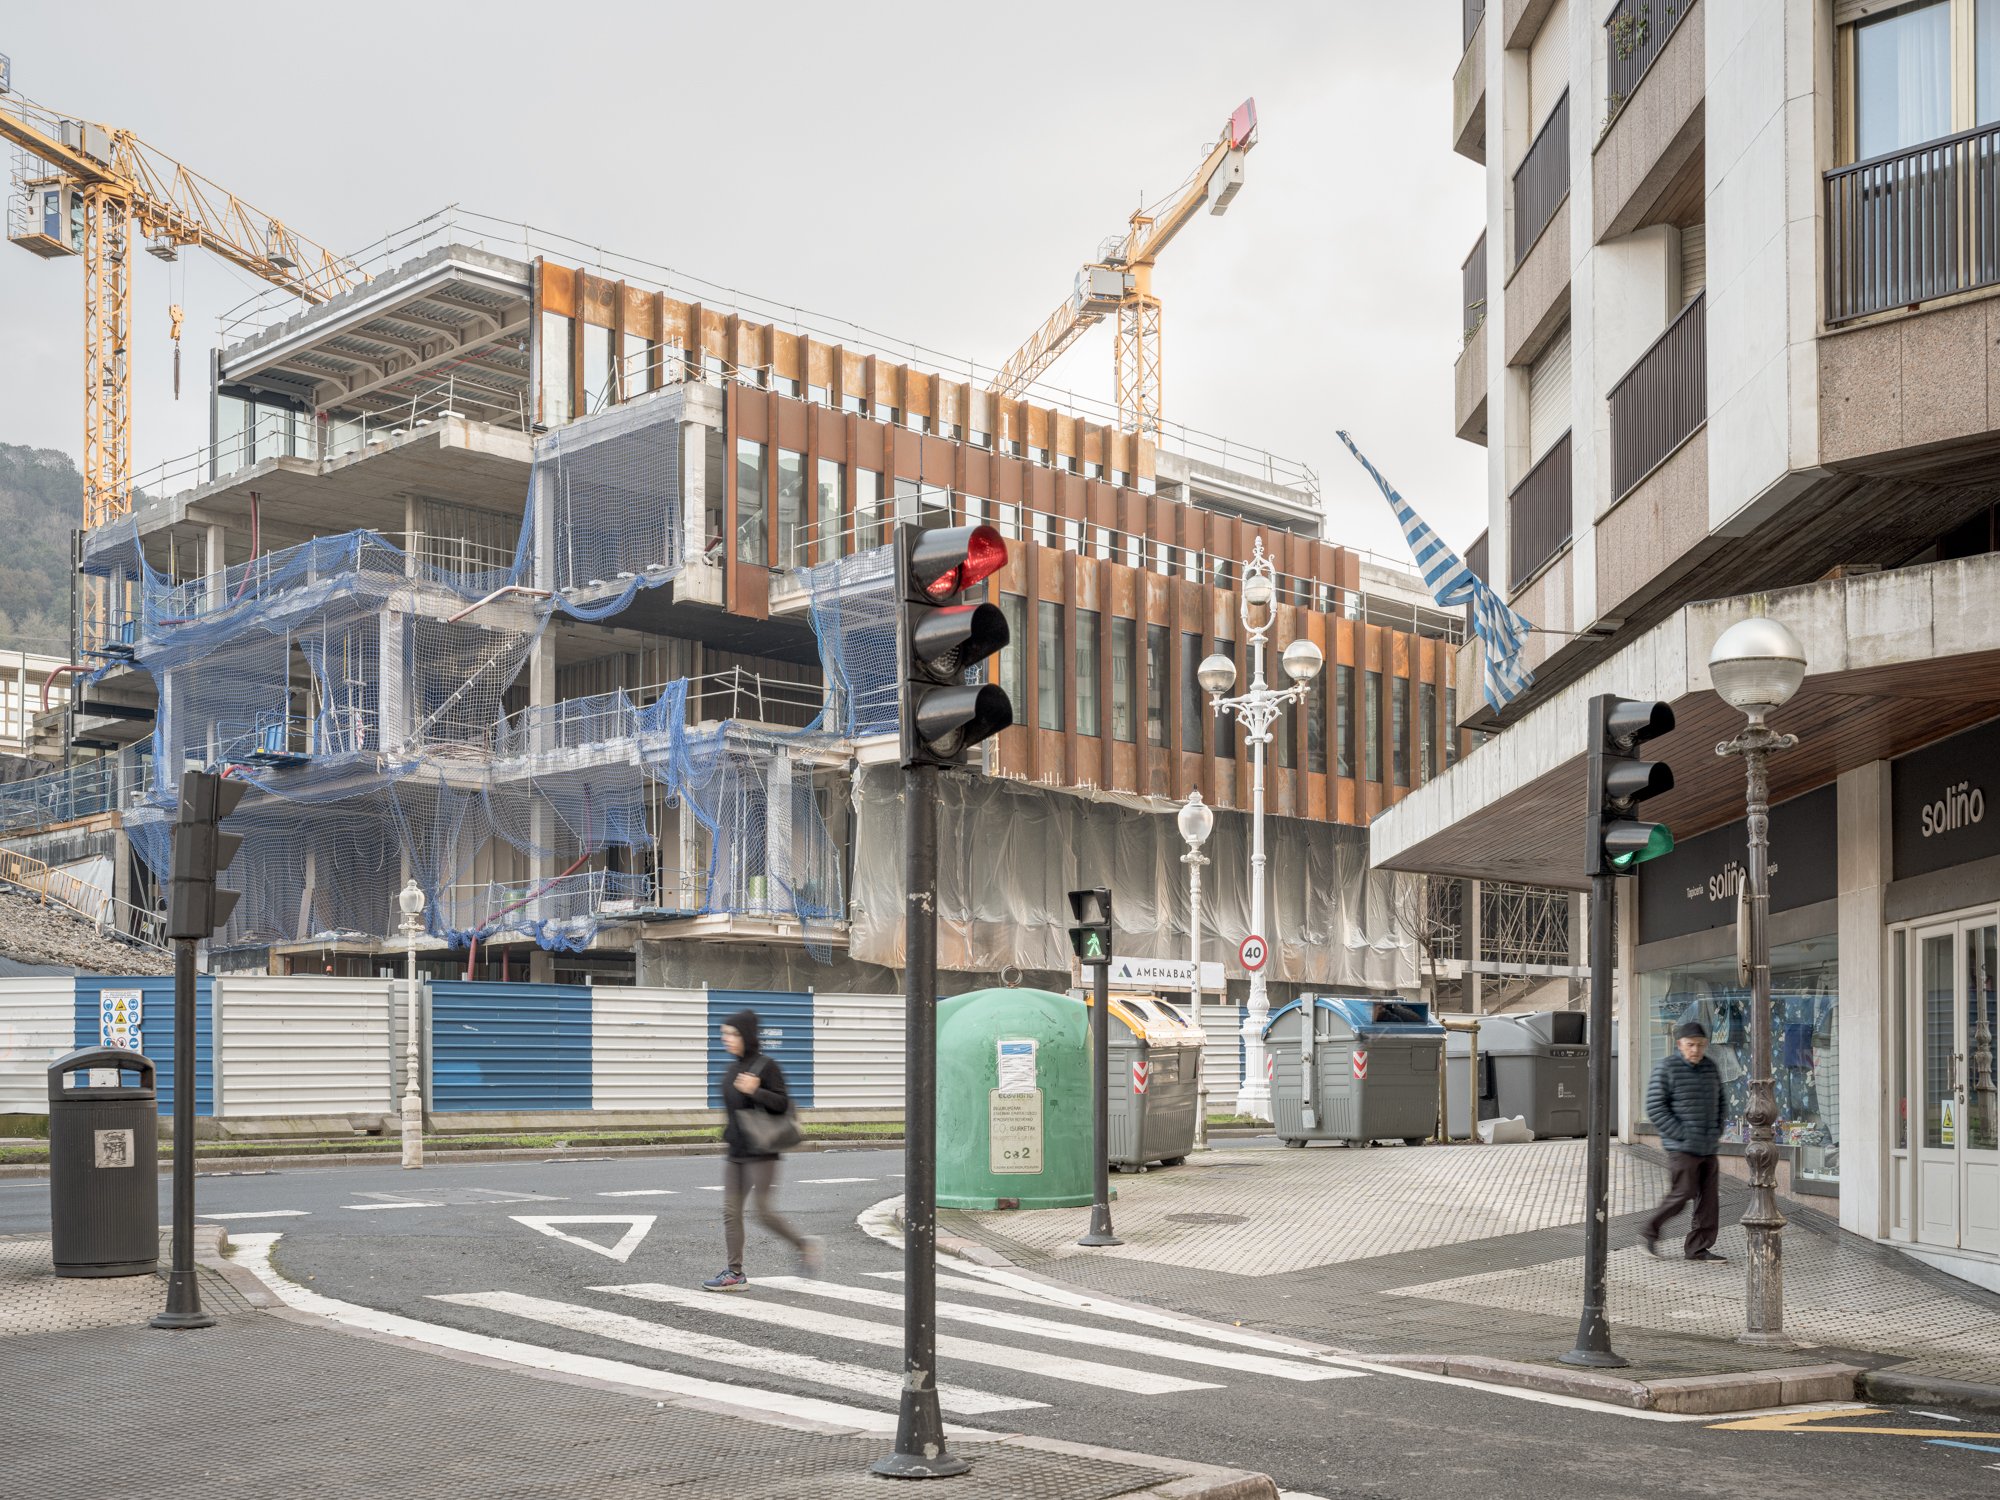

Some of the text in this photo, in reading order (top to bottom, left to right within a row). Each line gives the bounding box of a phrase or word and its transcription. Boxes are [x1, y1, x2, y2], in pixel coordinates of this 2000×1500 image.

[1922, 780, 1985, 837] soliño
[1245, 947, 1261, 959] 40
[1136, 967, 1192, 979] AMENABAR
